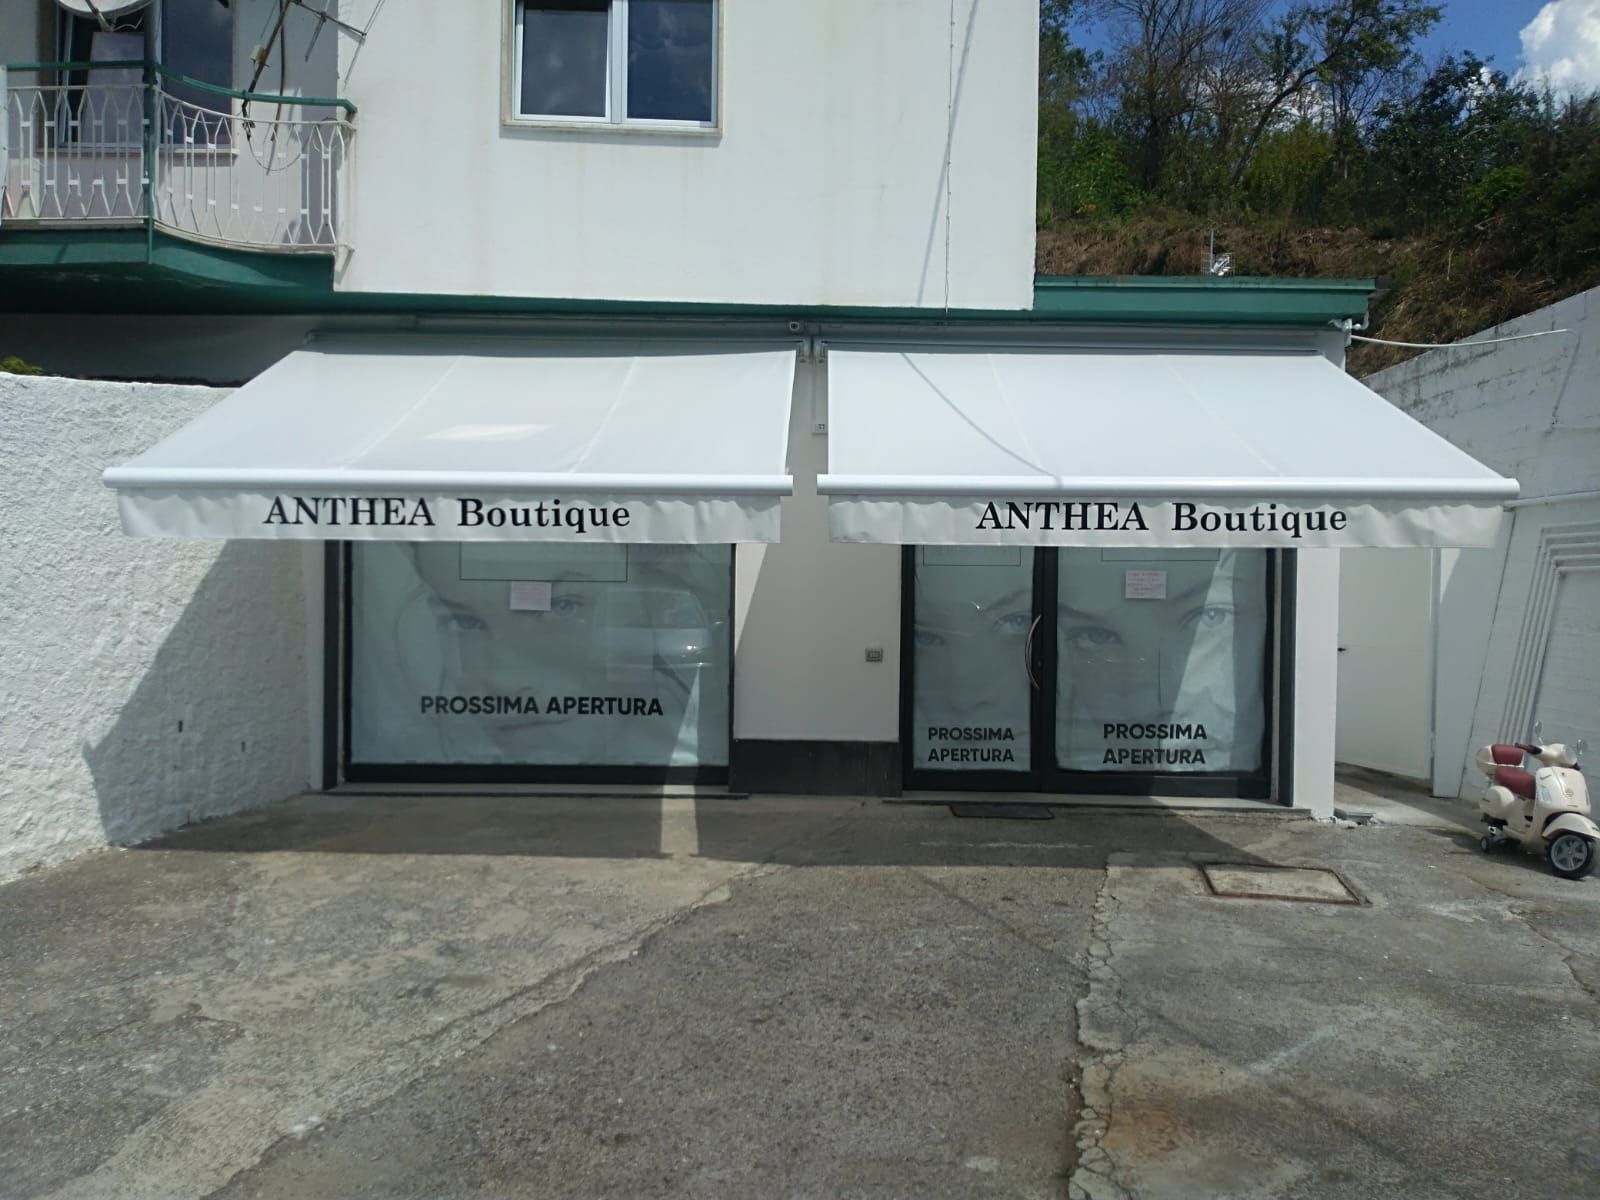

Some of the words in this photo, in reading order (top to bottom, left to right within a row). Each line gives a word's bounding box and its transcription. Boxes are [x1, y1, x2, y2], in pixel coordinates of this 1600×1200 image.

[263, 496, 436, 526] ANTHEA
[456, 497, 631, 534] Boutique
[975, 501, 1150, 531] ANTHEA
[1171, 502, 1348, 538] Boutique
[420, 695, 540, 715] PROSSIMA
[545, 696, 664, 716] APERTURA
[927, 726, 1015, 742] PROSSIMA
[1103, 722, 1208, 740] PROSSIMA
[927, 747, 1015, 763] APERTURA
[1102, 747, 1206, 765] APERTURA
